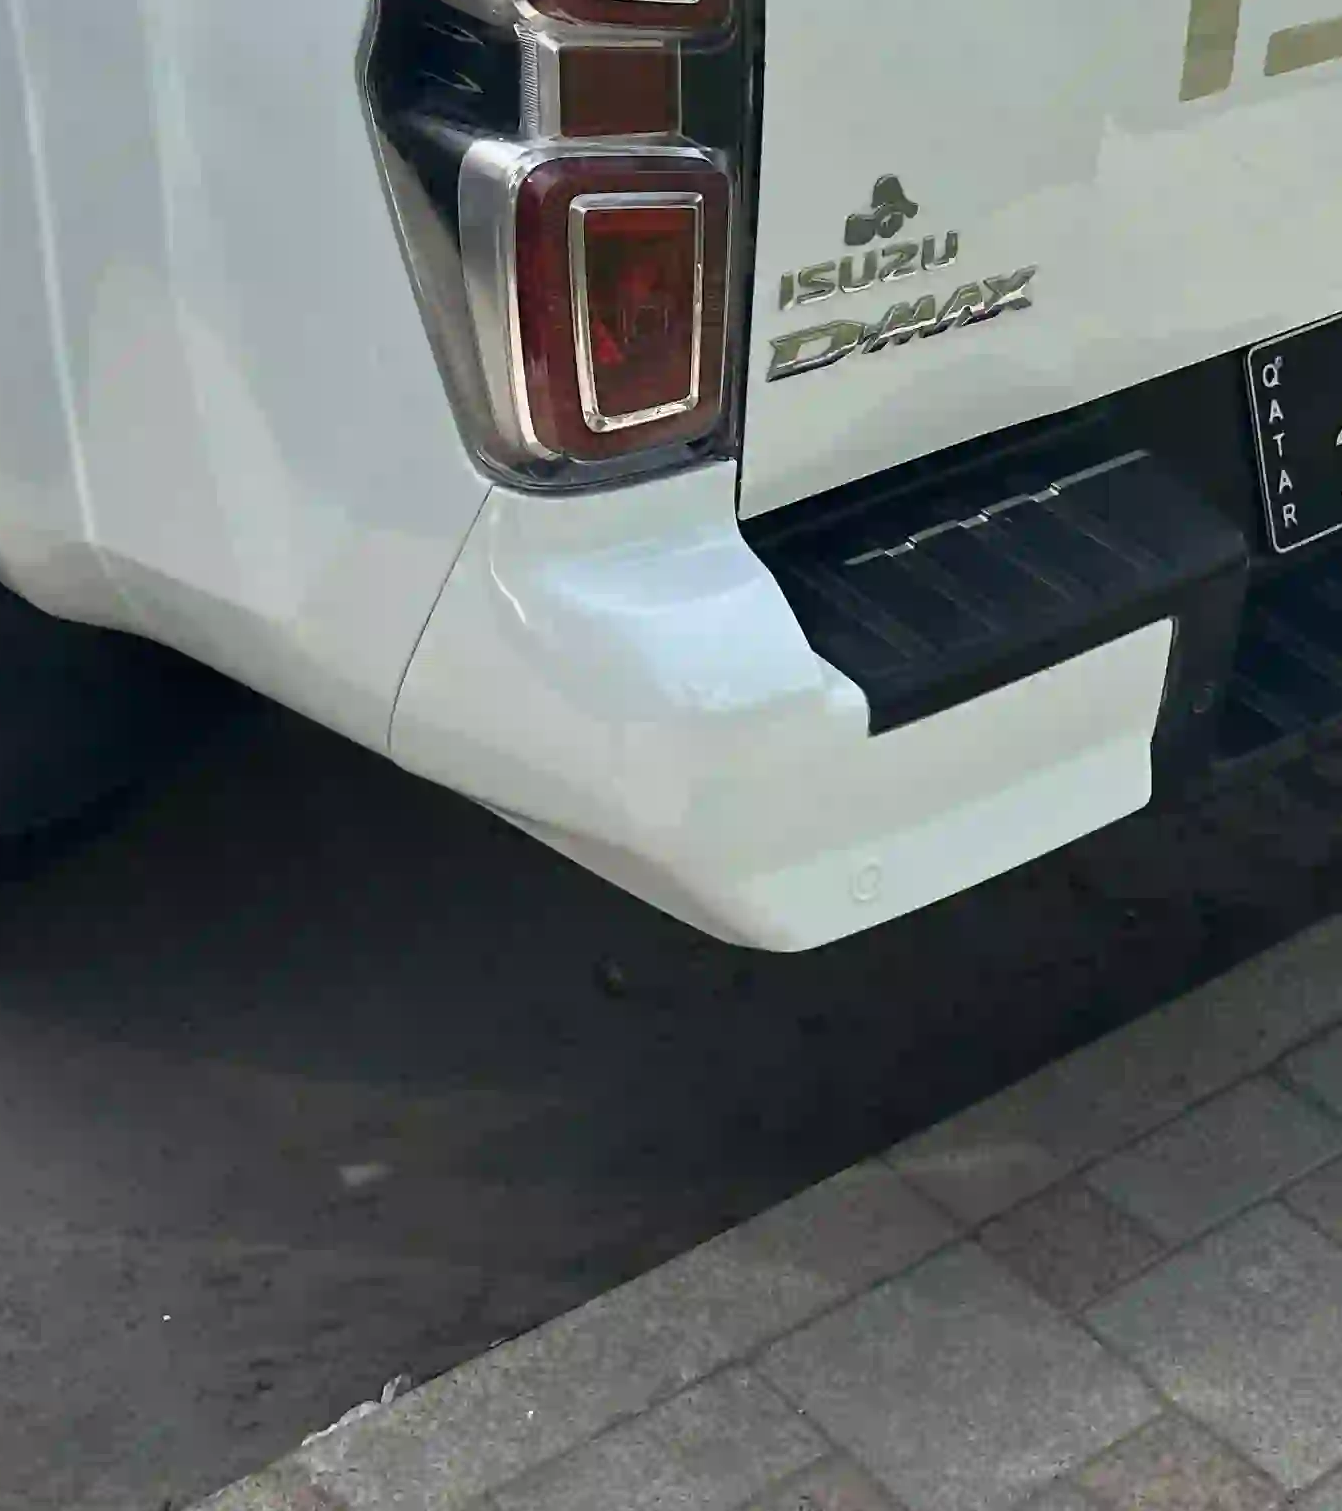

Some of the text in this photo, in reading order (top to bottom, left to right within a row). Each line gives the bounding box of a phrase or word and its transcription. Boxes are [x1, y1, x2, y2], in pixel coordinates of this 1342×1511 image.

[766, 263, 1038, 382] D-MAX
[779, 230, 959, 312] ISUZU
[1262, 358, 1298, 528] QATAR
